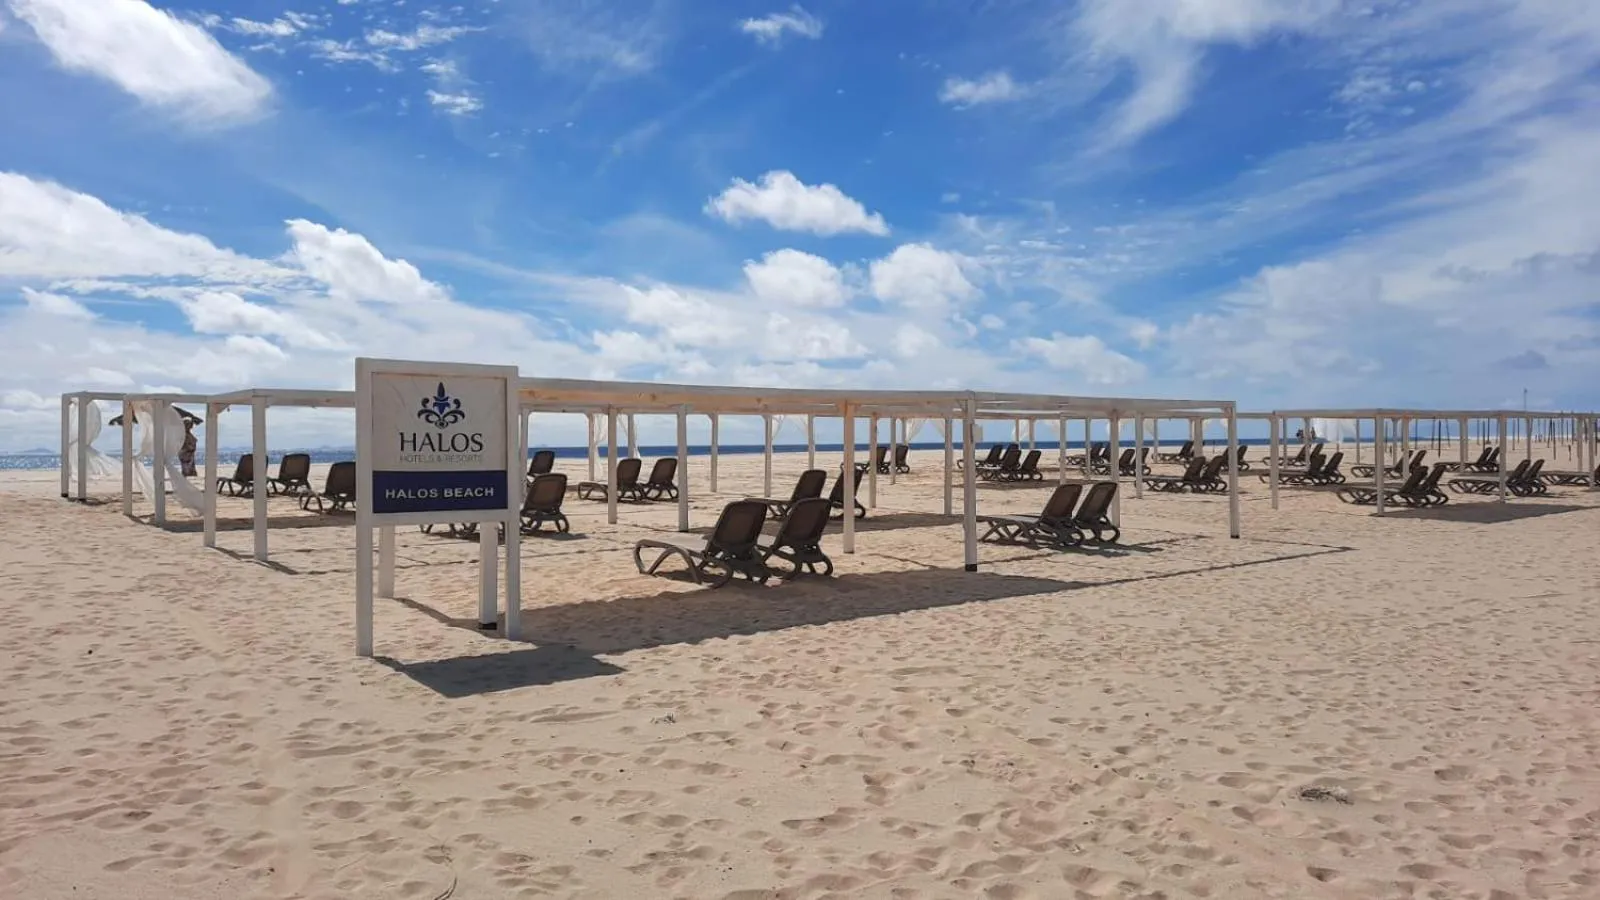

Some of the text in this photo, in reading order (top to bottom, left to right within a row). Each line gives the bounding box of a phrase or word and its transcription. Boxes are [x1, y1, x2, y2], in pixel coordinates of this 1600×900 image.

[399, 432, 483, 452] HALOS
[399, 454, 483, 463] HOTELS & RESORTS
[385, 487, 494, 499] HALOS BEACH
